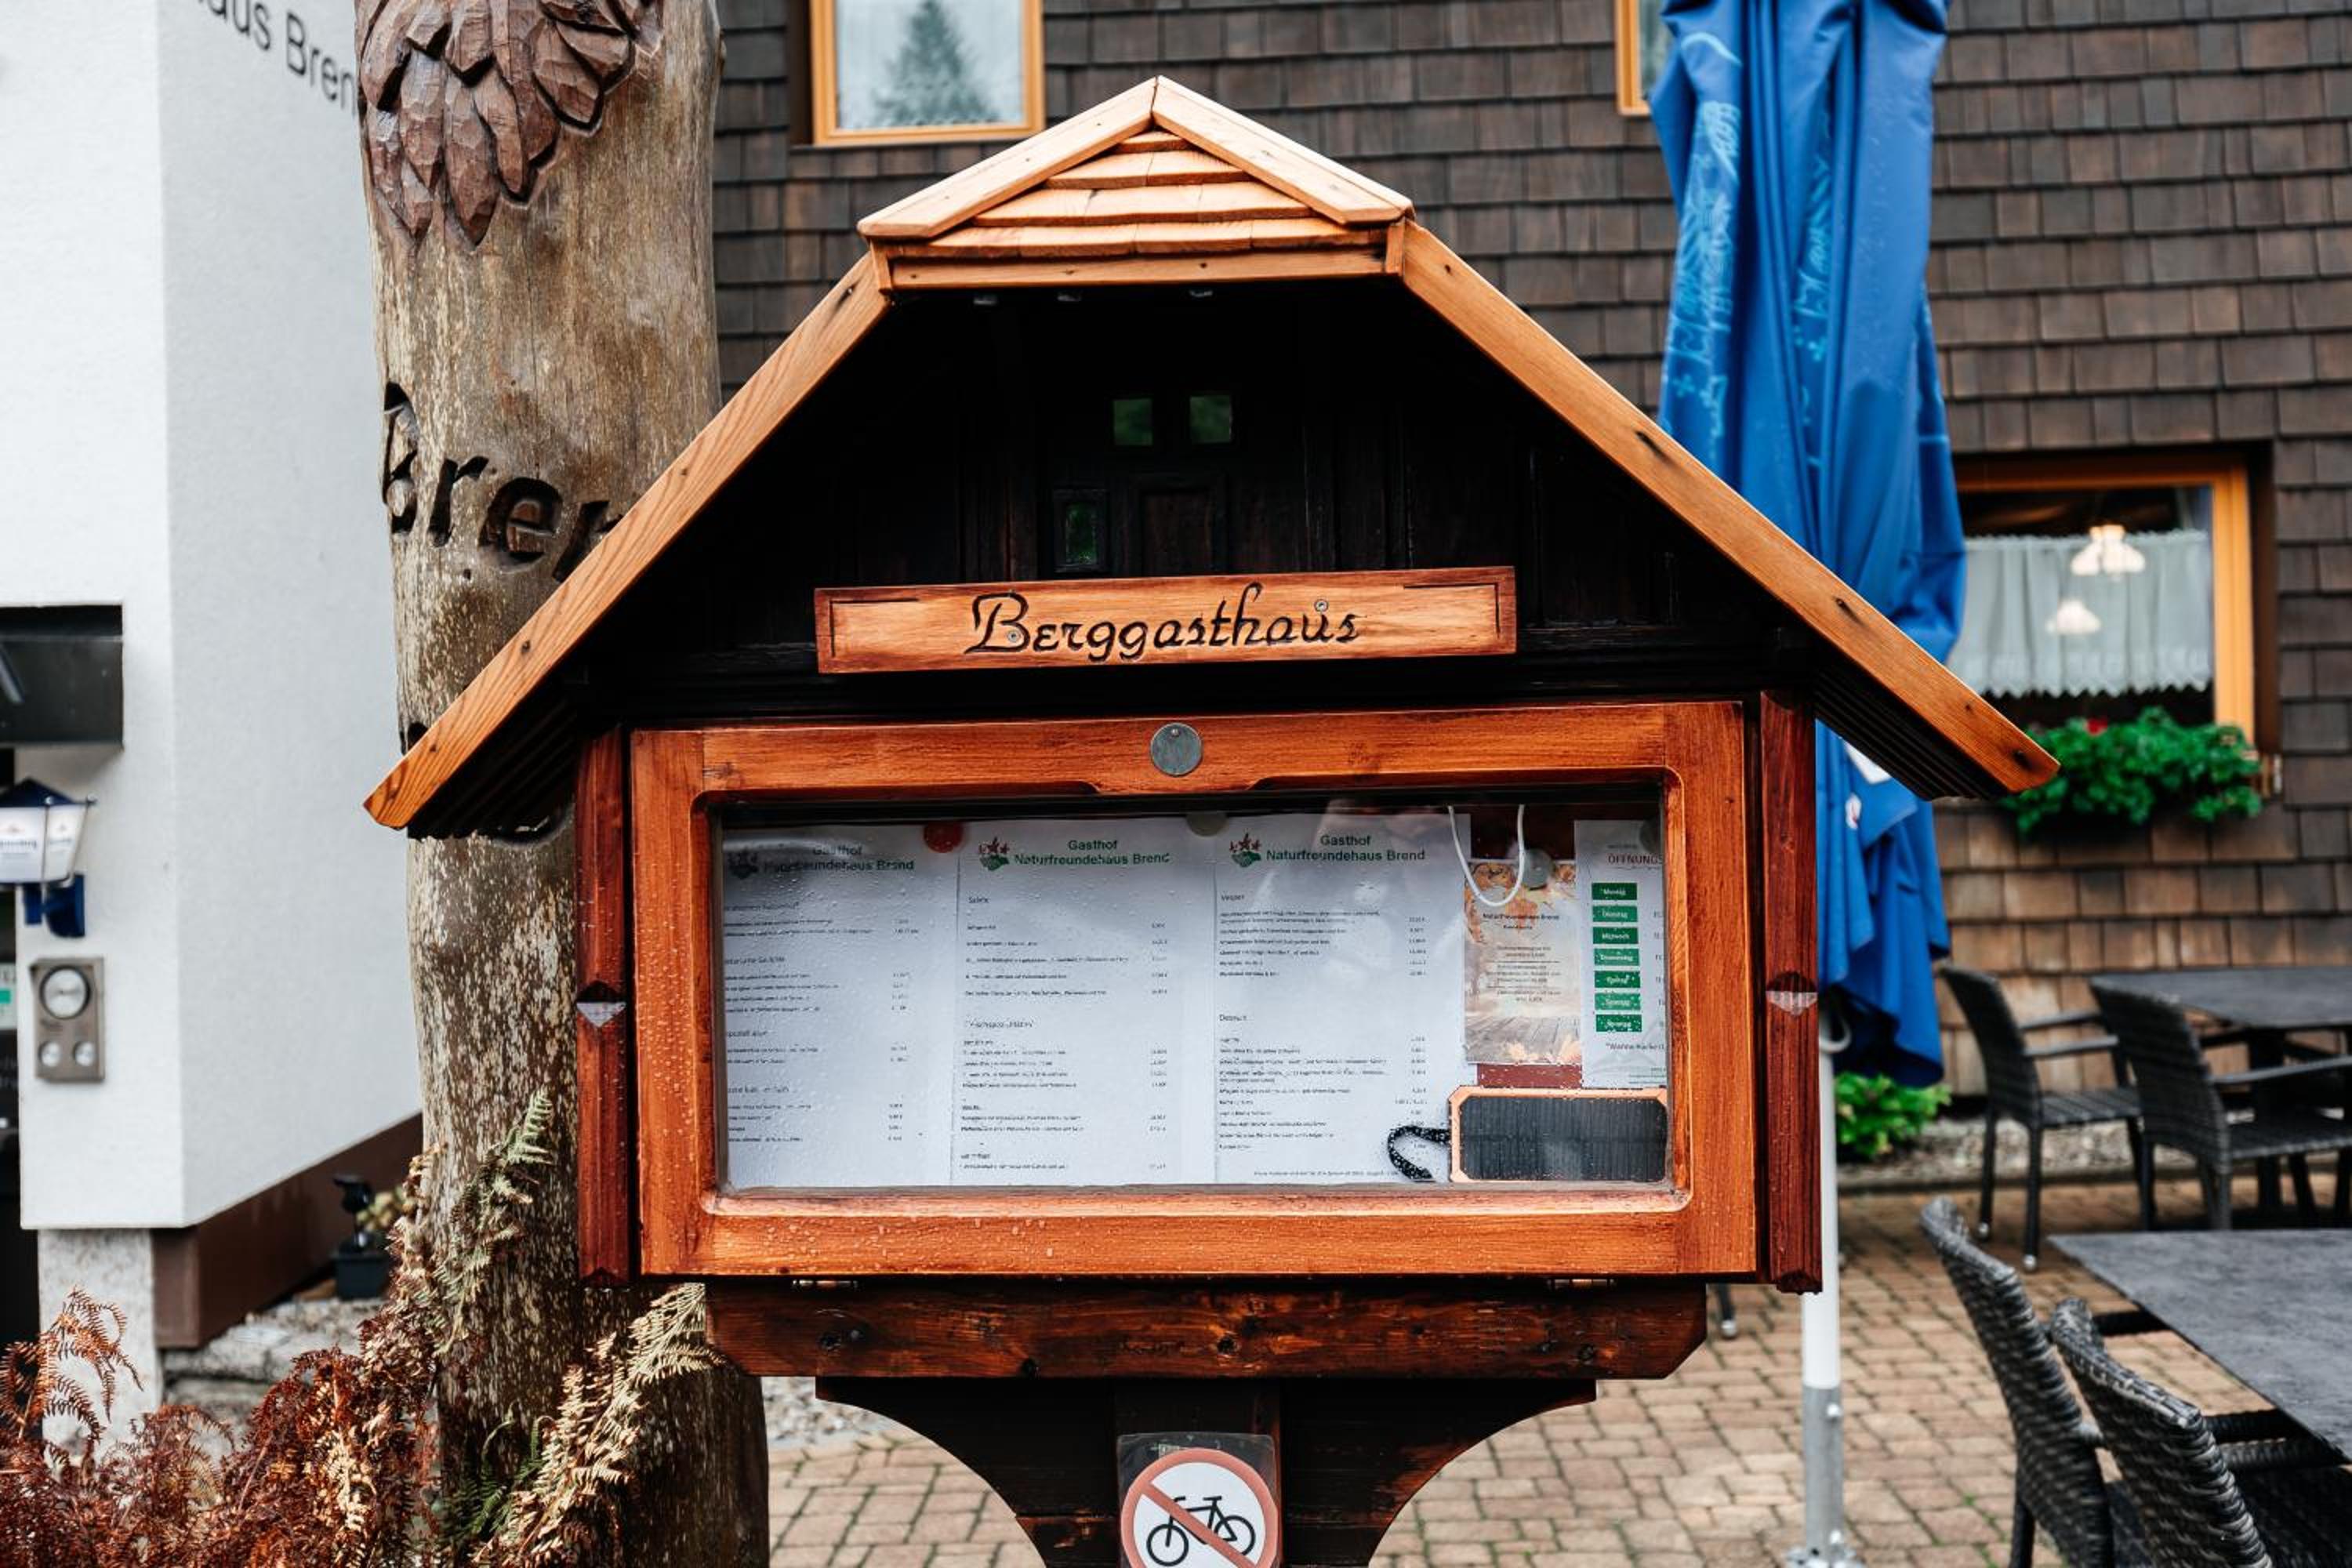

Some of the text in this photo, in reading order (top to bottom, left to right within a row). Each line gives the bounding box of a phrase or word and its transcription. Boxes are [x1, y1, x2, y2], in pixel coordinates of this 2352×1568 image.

[286, 12, 355, 116] Bren
[964, 582, 1363, 662] Berggasthaus
[1068, 840, 1118, 851] Gasthof
[1319, 834, 1371, 846] Gasthof
[1266, 849, 1382, 861] Naturfreundehaus
